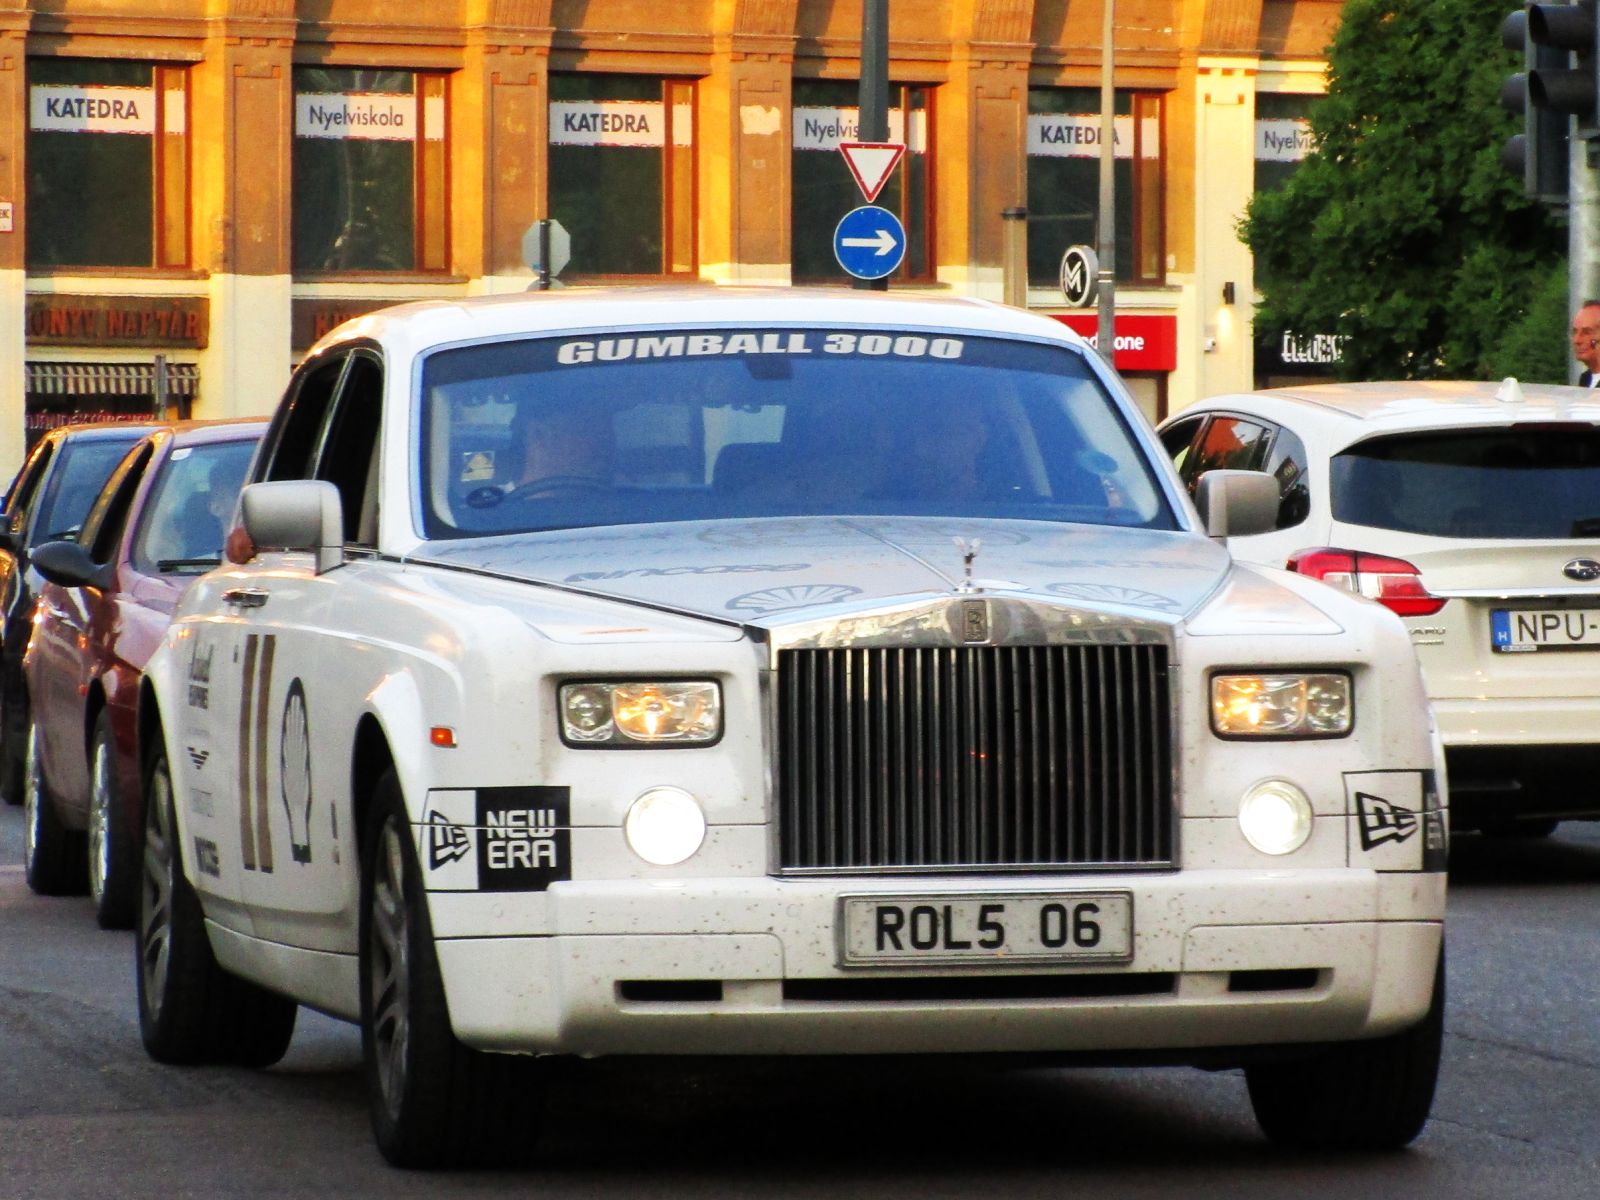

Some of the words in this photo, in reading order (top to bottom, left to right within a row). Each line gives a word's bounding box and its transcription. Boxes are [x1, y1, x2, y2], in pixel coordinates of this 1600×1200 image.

[46, 97, 139, 119] KATEDRA
[309, 104, 403, 130] Nyelviskola
[564, 113, 650, 133] KATEDRA
[557, 334, 813, 365] GUMBALL
[823, 334, 965, 359] 3000
[1499, 632, 1507, 642] H
[486, 808, 556, 839] NEW
[487, 839, 557, 869] ERA
[876, 904, 1005, 951] ROL5
[1040, 902, 1101, 948] 06
